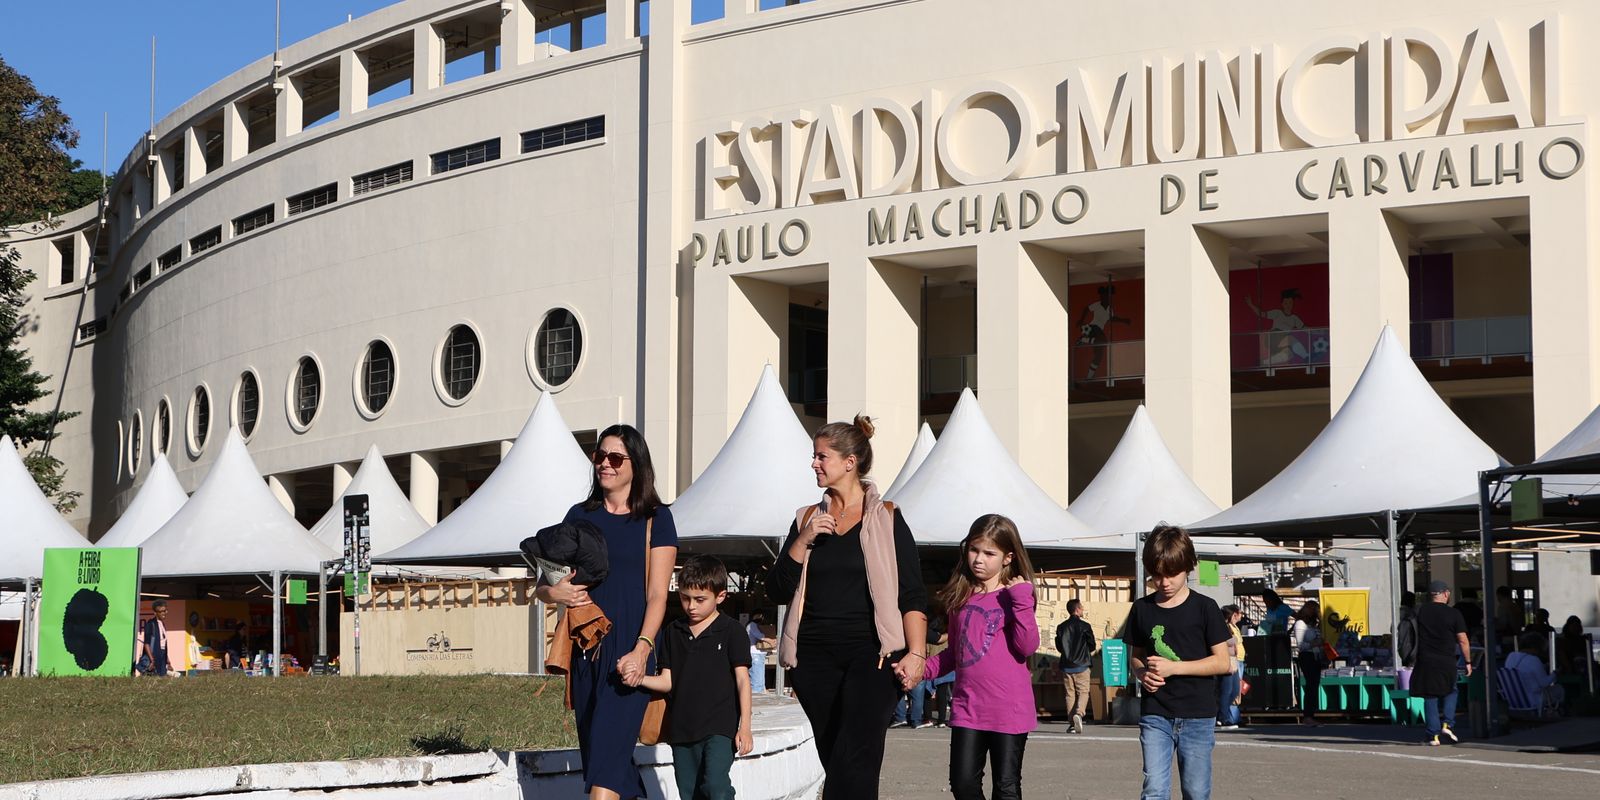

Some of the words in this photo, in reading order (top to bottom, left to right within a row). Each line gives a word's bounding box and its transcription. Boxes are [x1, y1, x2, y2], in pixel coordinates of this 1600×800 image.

[696, 80, 1036, 221] ESTADIO
[1057, 12, 1585, 175] MUNICIPAL
[692, 219, 811, 268] PAULO
[868, 185, 1090, 246] MACHADO
[1160, 169, 1219, 215] DE
[1296, 137, 1585, 201] CARVALHO
[83, 568, 101, 584] LIVRO
[85, 551, 101, 567] FEIRA
